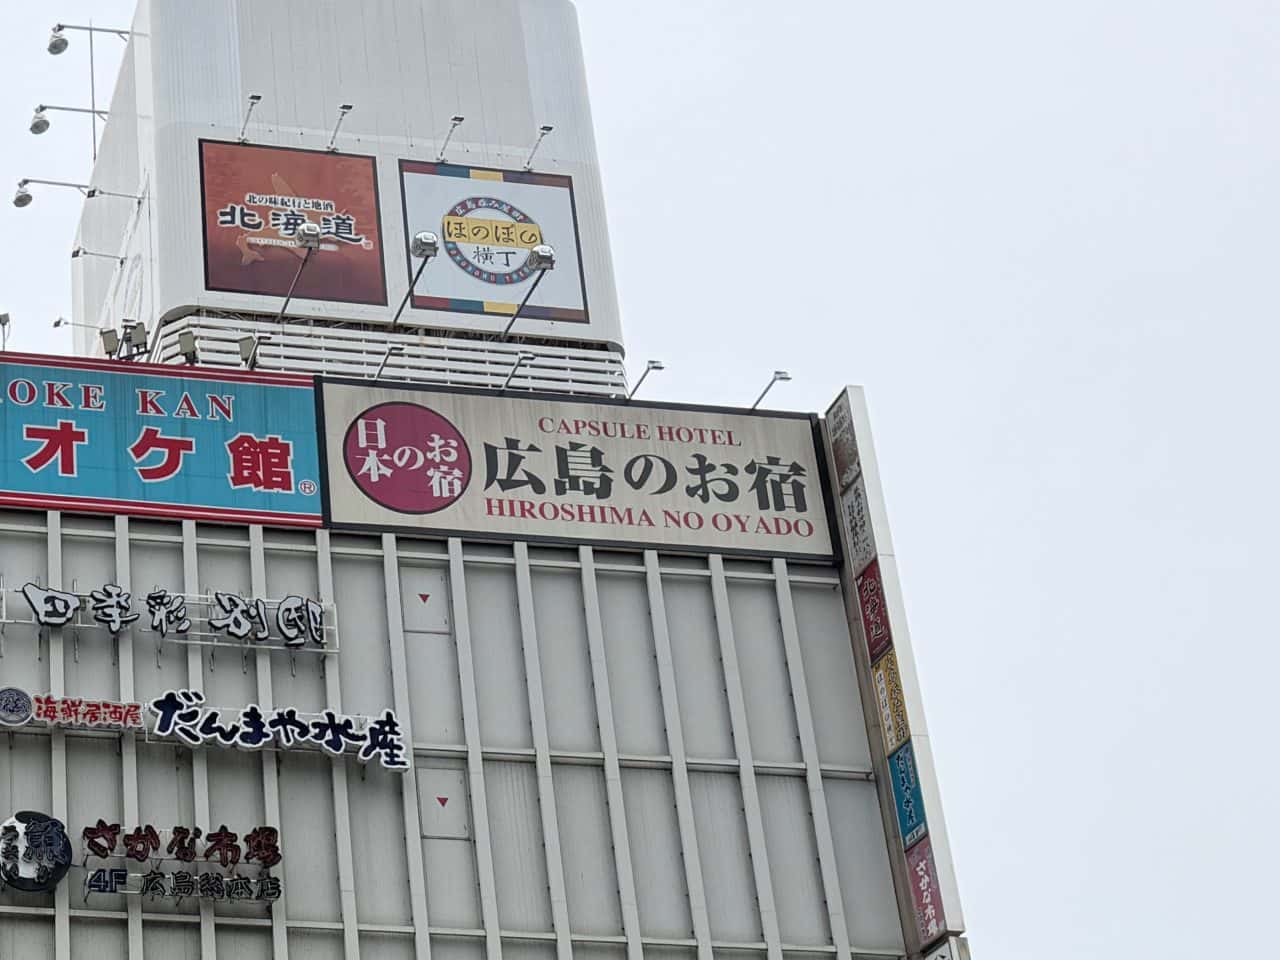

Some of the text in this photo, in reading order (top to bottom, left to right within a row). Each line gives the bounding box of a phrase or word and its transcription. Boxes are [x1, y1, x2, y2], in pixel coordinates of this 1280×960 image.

[218, 205, 363, 243] 北海道
[446, 221, 538, 245] ほのぼの
[472, 245, 517, 268] 横丁
[136, 388, 235, 421] KAN
[537, 416, 742, 447] CAPSULE HOTEL
[482, 437, 810, 514] 広島のお宿
[485, 498, 814, 538] HIROSHIMA NO OYADO
[33, 694, 143, 727] 海鮮居酒屋
[152, 689, 410, 771] だんまや水産
[82, 819, 282, 867] さかな市場
[87, 868, 128, 893] 4F
